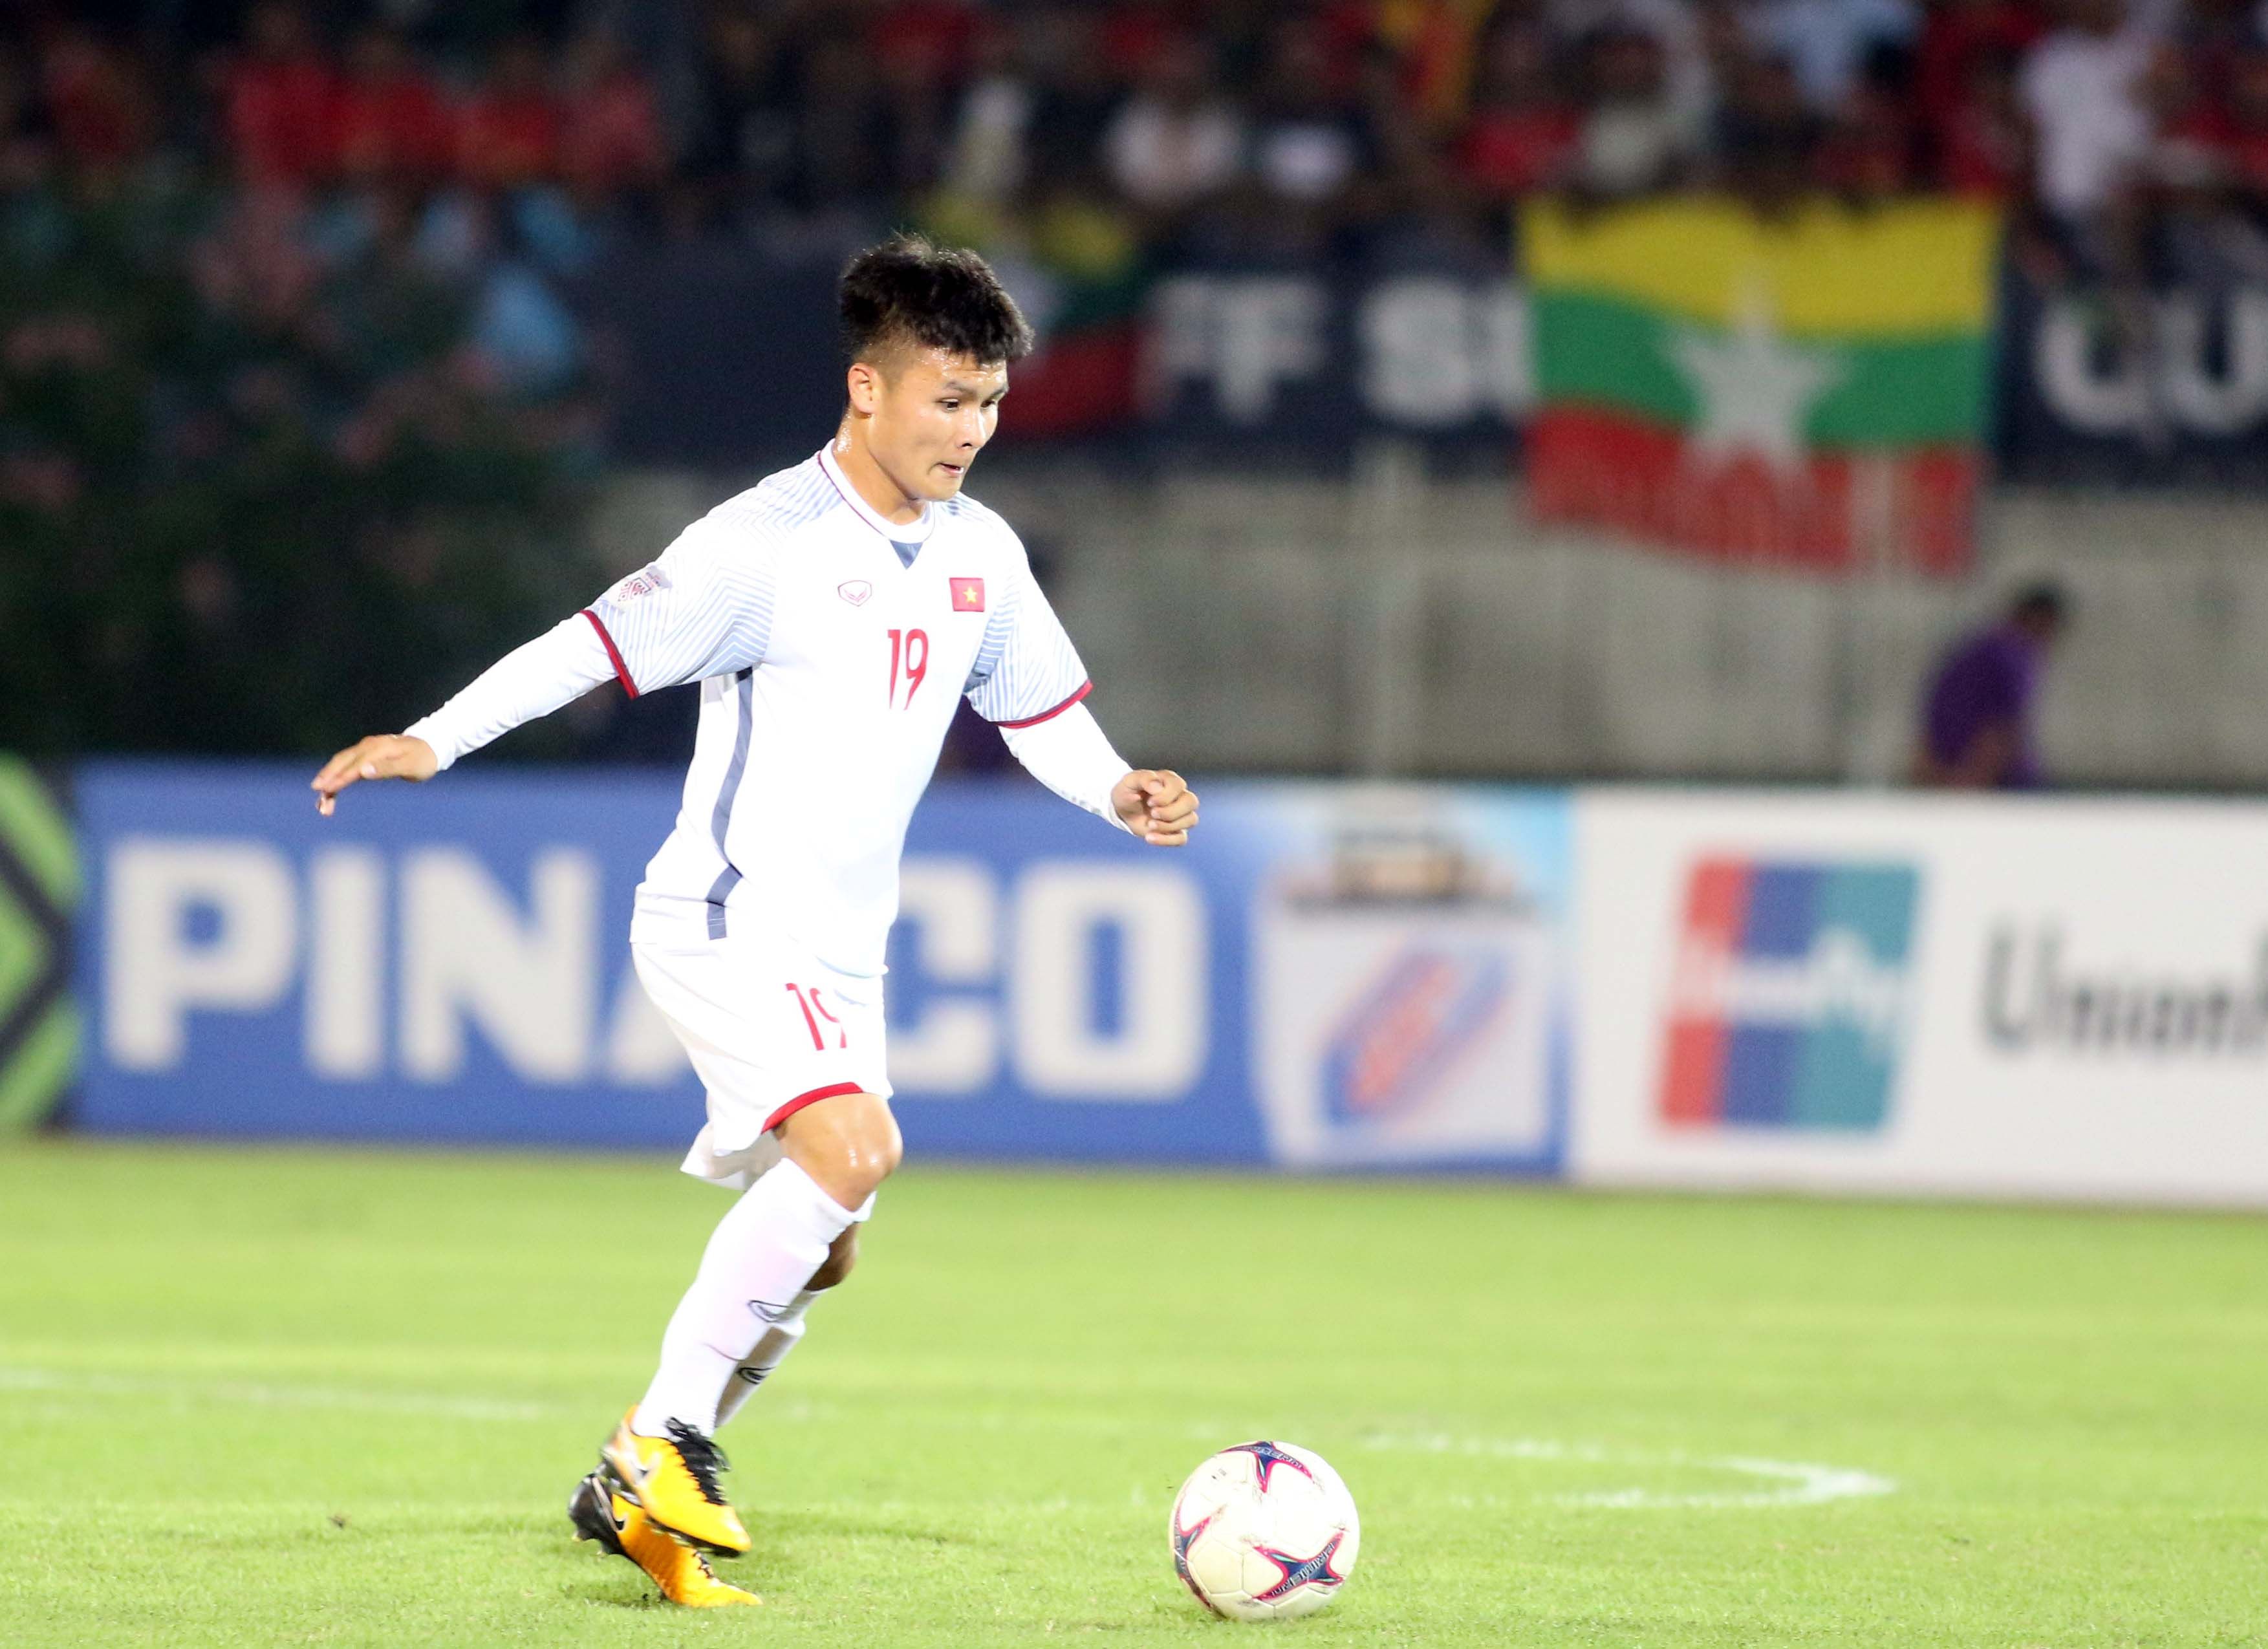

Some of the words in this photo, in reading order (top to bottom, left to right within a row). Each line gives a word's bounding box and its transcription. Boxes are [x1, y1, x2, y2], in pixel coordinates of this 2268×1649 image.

[887, 628, 929, 711] 19
[105, 834, 1208, 1099] PINCO
[1982, 918, 2268, 1055] Union
